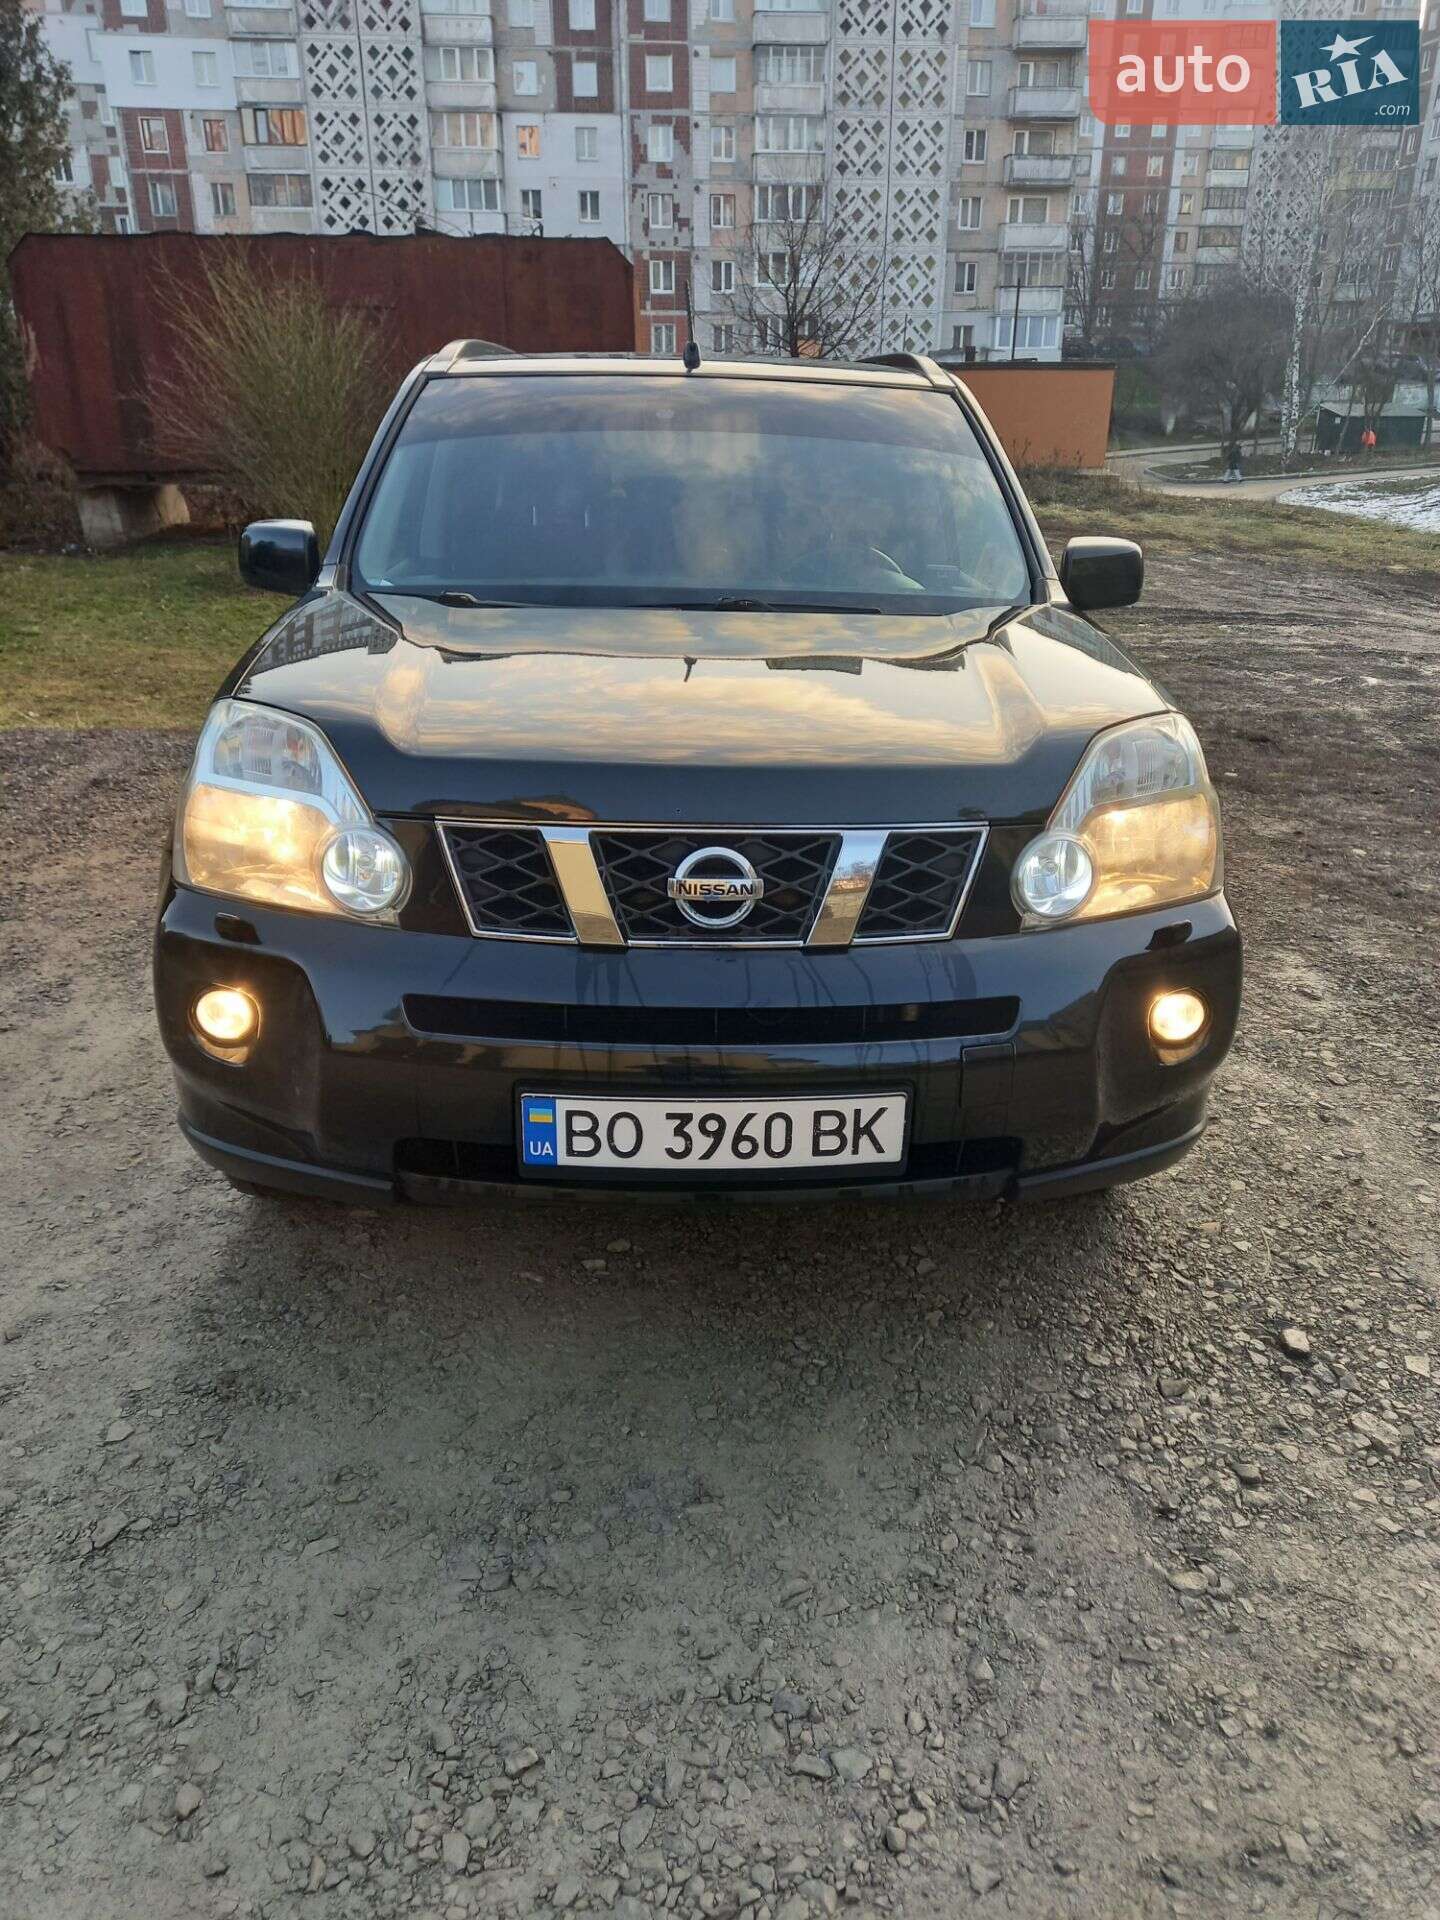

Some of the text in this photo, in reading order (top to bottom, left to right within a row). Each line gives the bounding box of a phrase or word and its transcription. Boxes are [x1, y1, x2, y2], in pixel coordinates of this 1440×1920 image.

[678, 883, 753, 896] NISSAN
[565, 1107, 889, 1160] BO 3960 BK
[530, 1141, 553, 1156] UA
